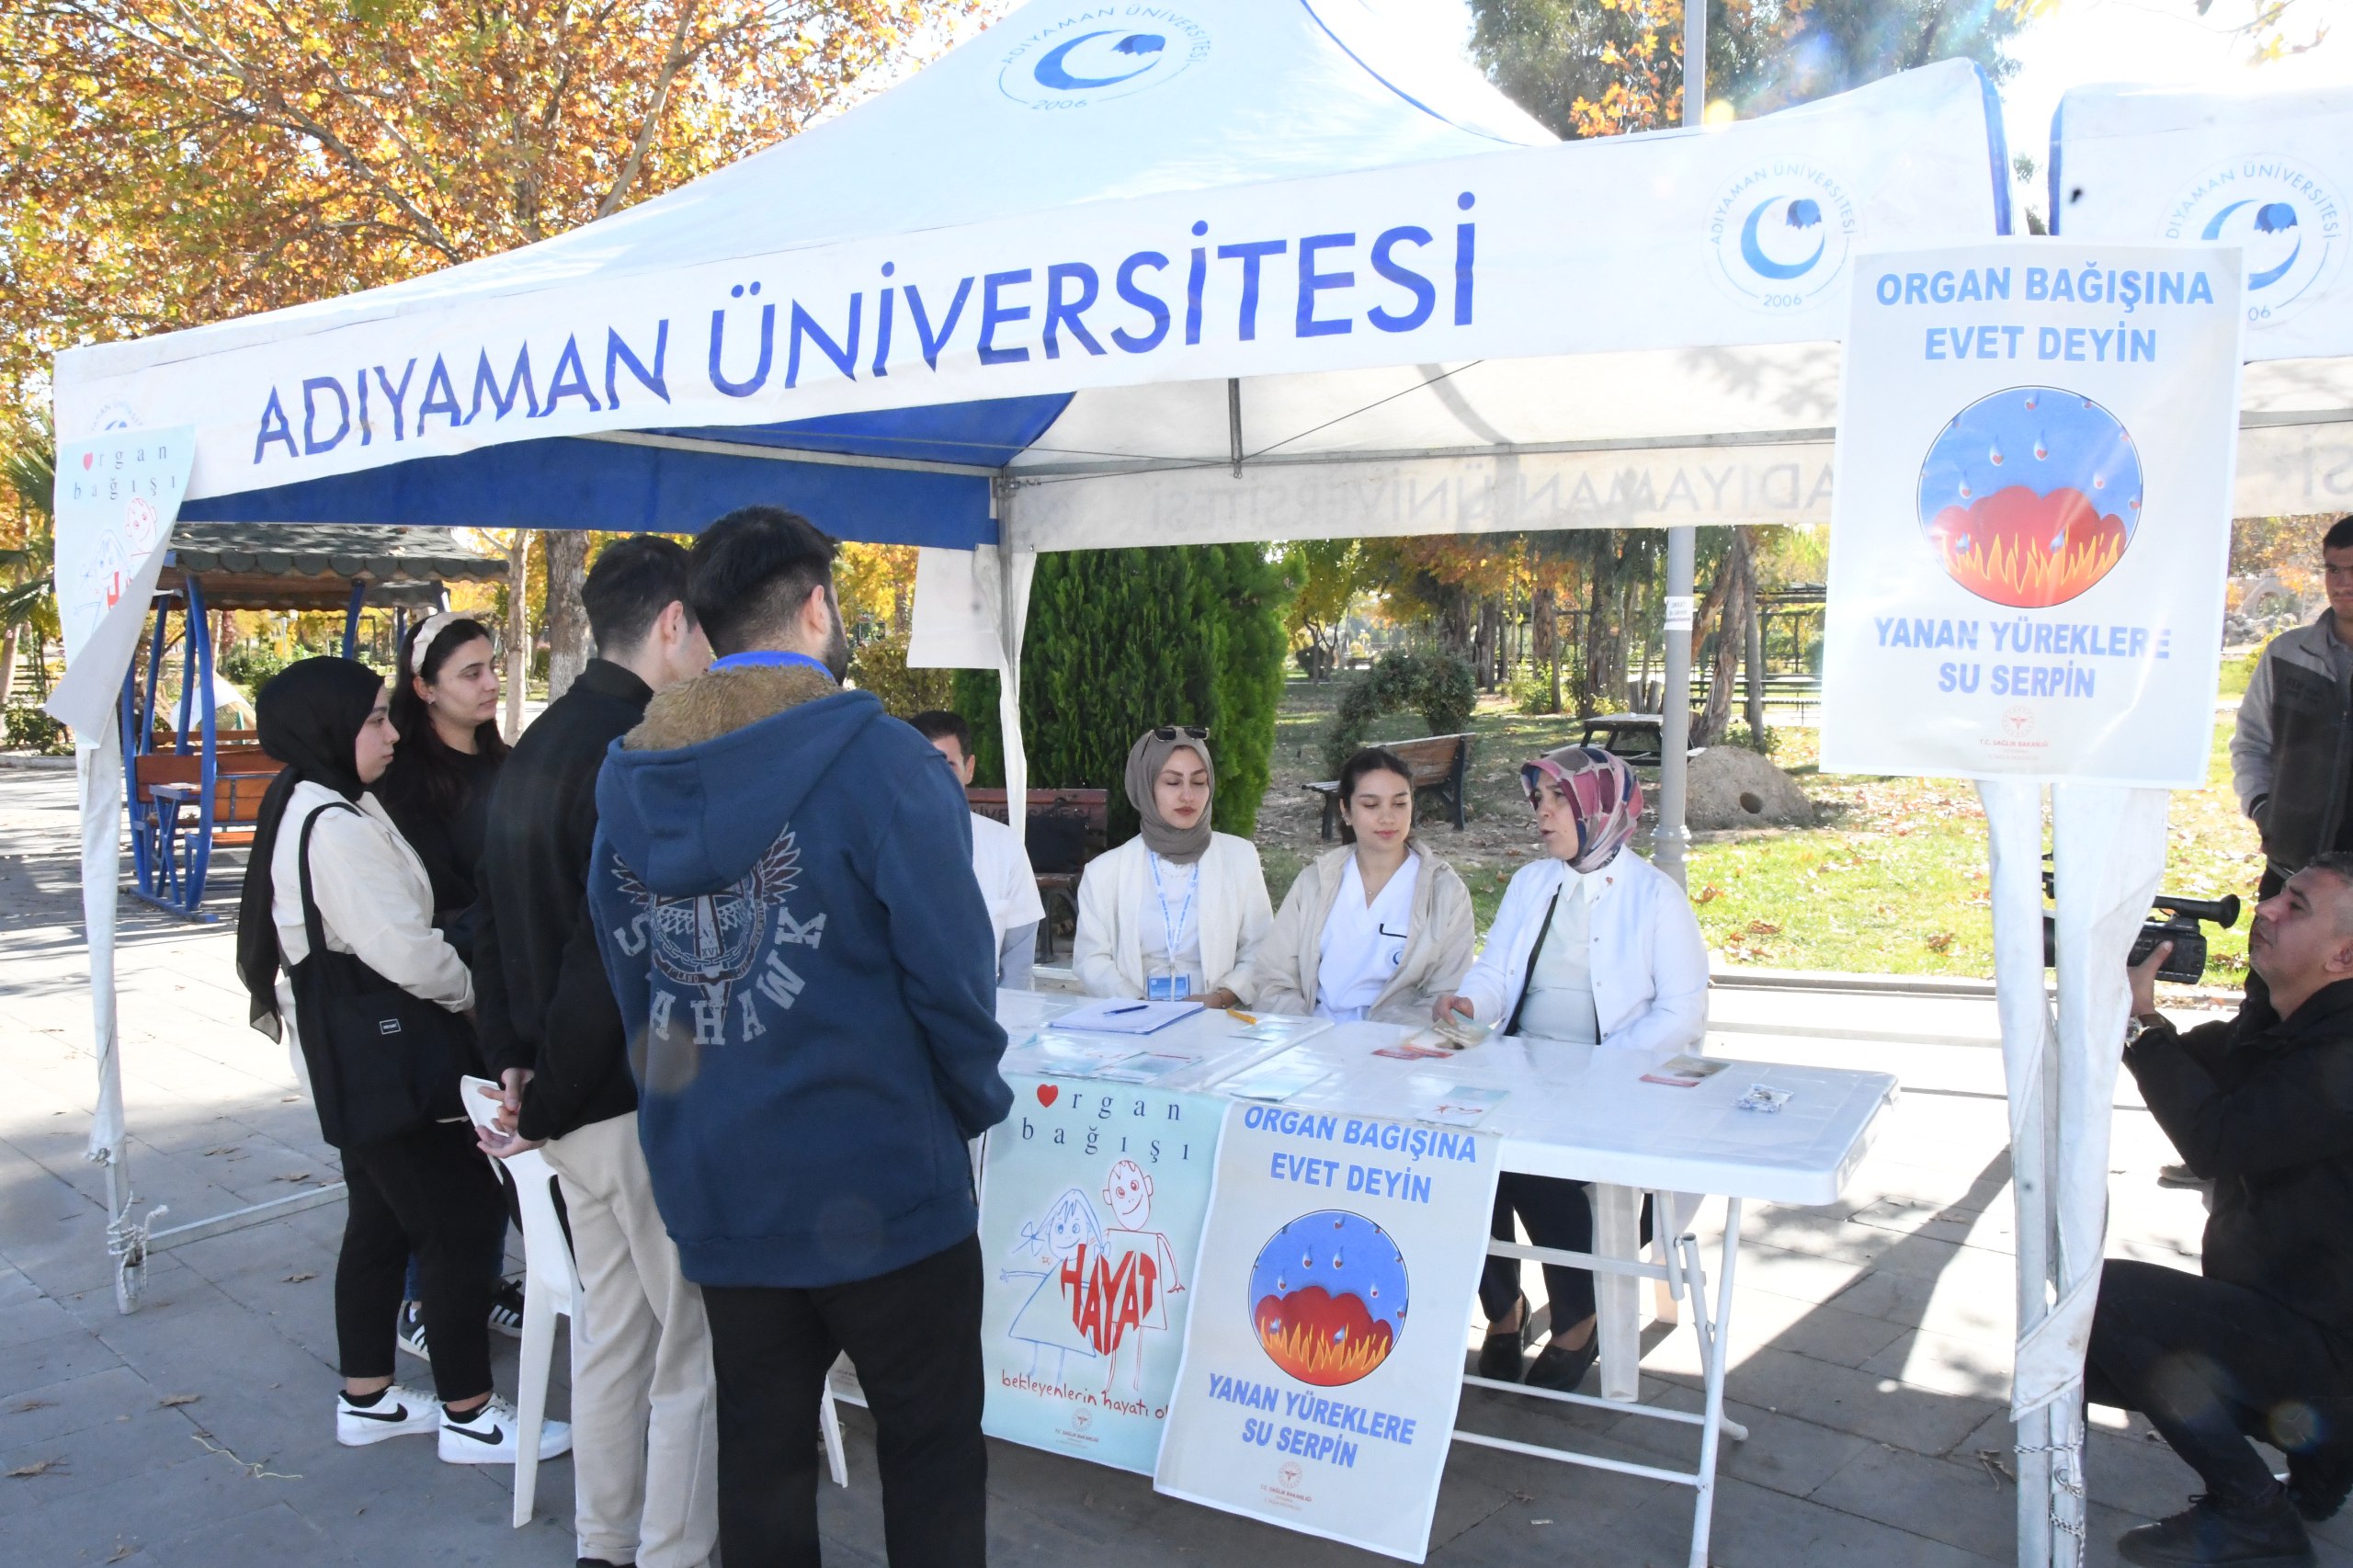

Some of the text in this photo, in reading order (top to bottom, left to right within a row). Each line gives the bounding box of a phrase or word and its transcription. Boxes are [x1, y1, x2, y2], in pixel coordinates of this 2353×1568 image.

[1001, 7, 1114, 64] ADIYAMAN
[1031, 98, 1087, 110] 2006
[1711, 168, 1767, 244] ADIYAMAN
[2165, 162, 2341, 239] DIYAMAN ÜNİVERSİTESİ
[1763, 294, 1802, 308] 2006
[1876, 260, 2214, 313] ORGAN BAĞIŞINA
[253, 190, 1477, 464] ADIYAMAN ÜNİVERSİTESİ
[2248, 305, 2271, 322] 06
[1925, 321, 2156, 363] EVET DEYİN
[1874, 616, 2170, 659] YANAN YÜREKLERE
[1938, 659, 2096, 699] SU SERPİN
[1022, 1117, 1189, 1164] bağışı
[1244, 1106, 1338, 1141] ORGAN
[1270, 1153, 1432, 1203] EVET DEYİN
[1061, 1244, 1157, 1356] HAYAT
[1001, 1369, 1097, 1407] bekleyenlerin
[1101, 1389, 1149, 1416] hayatı
[1210, 1373, 1417, 1445] YANAN YÜREKLERE
[1243, 1418, 1358, 1469] SU SERPİN
